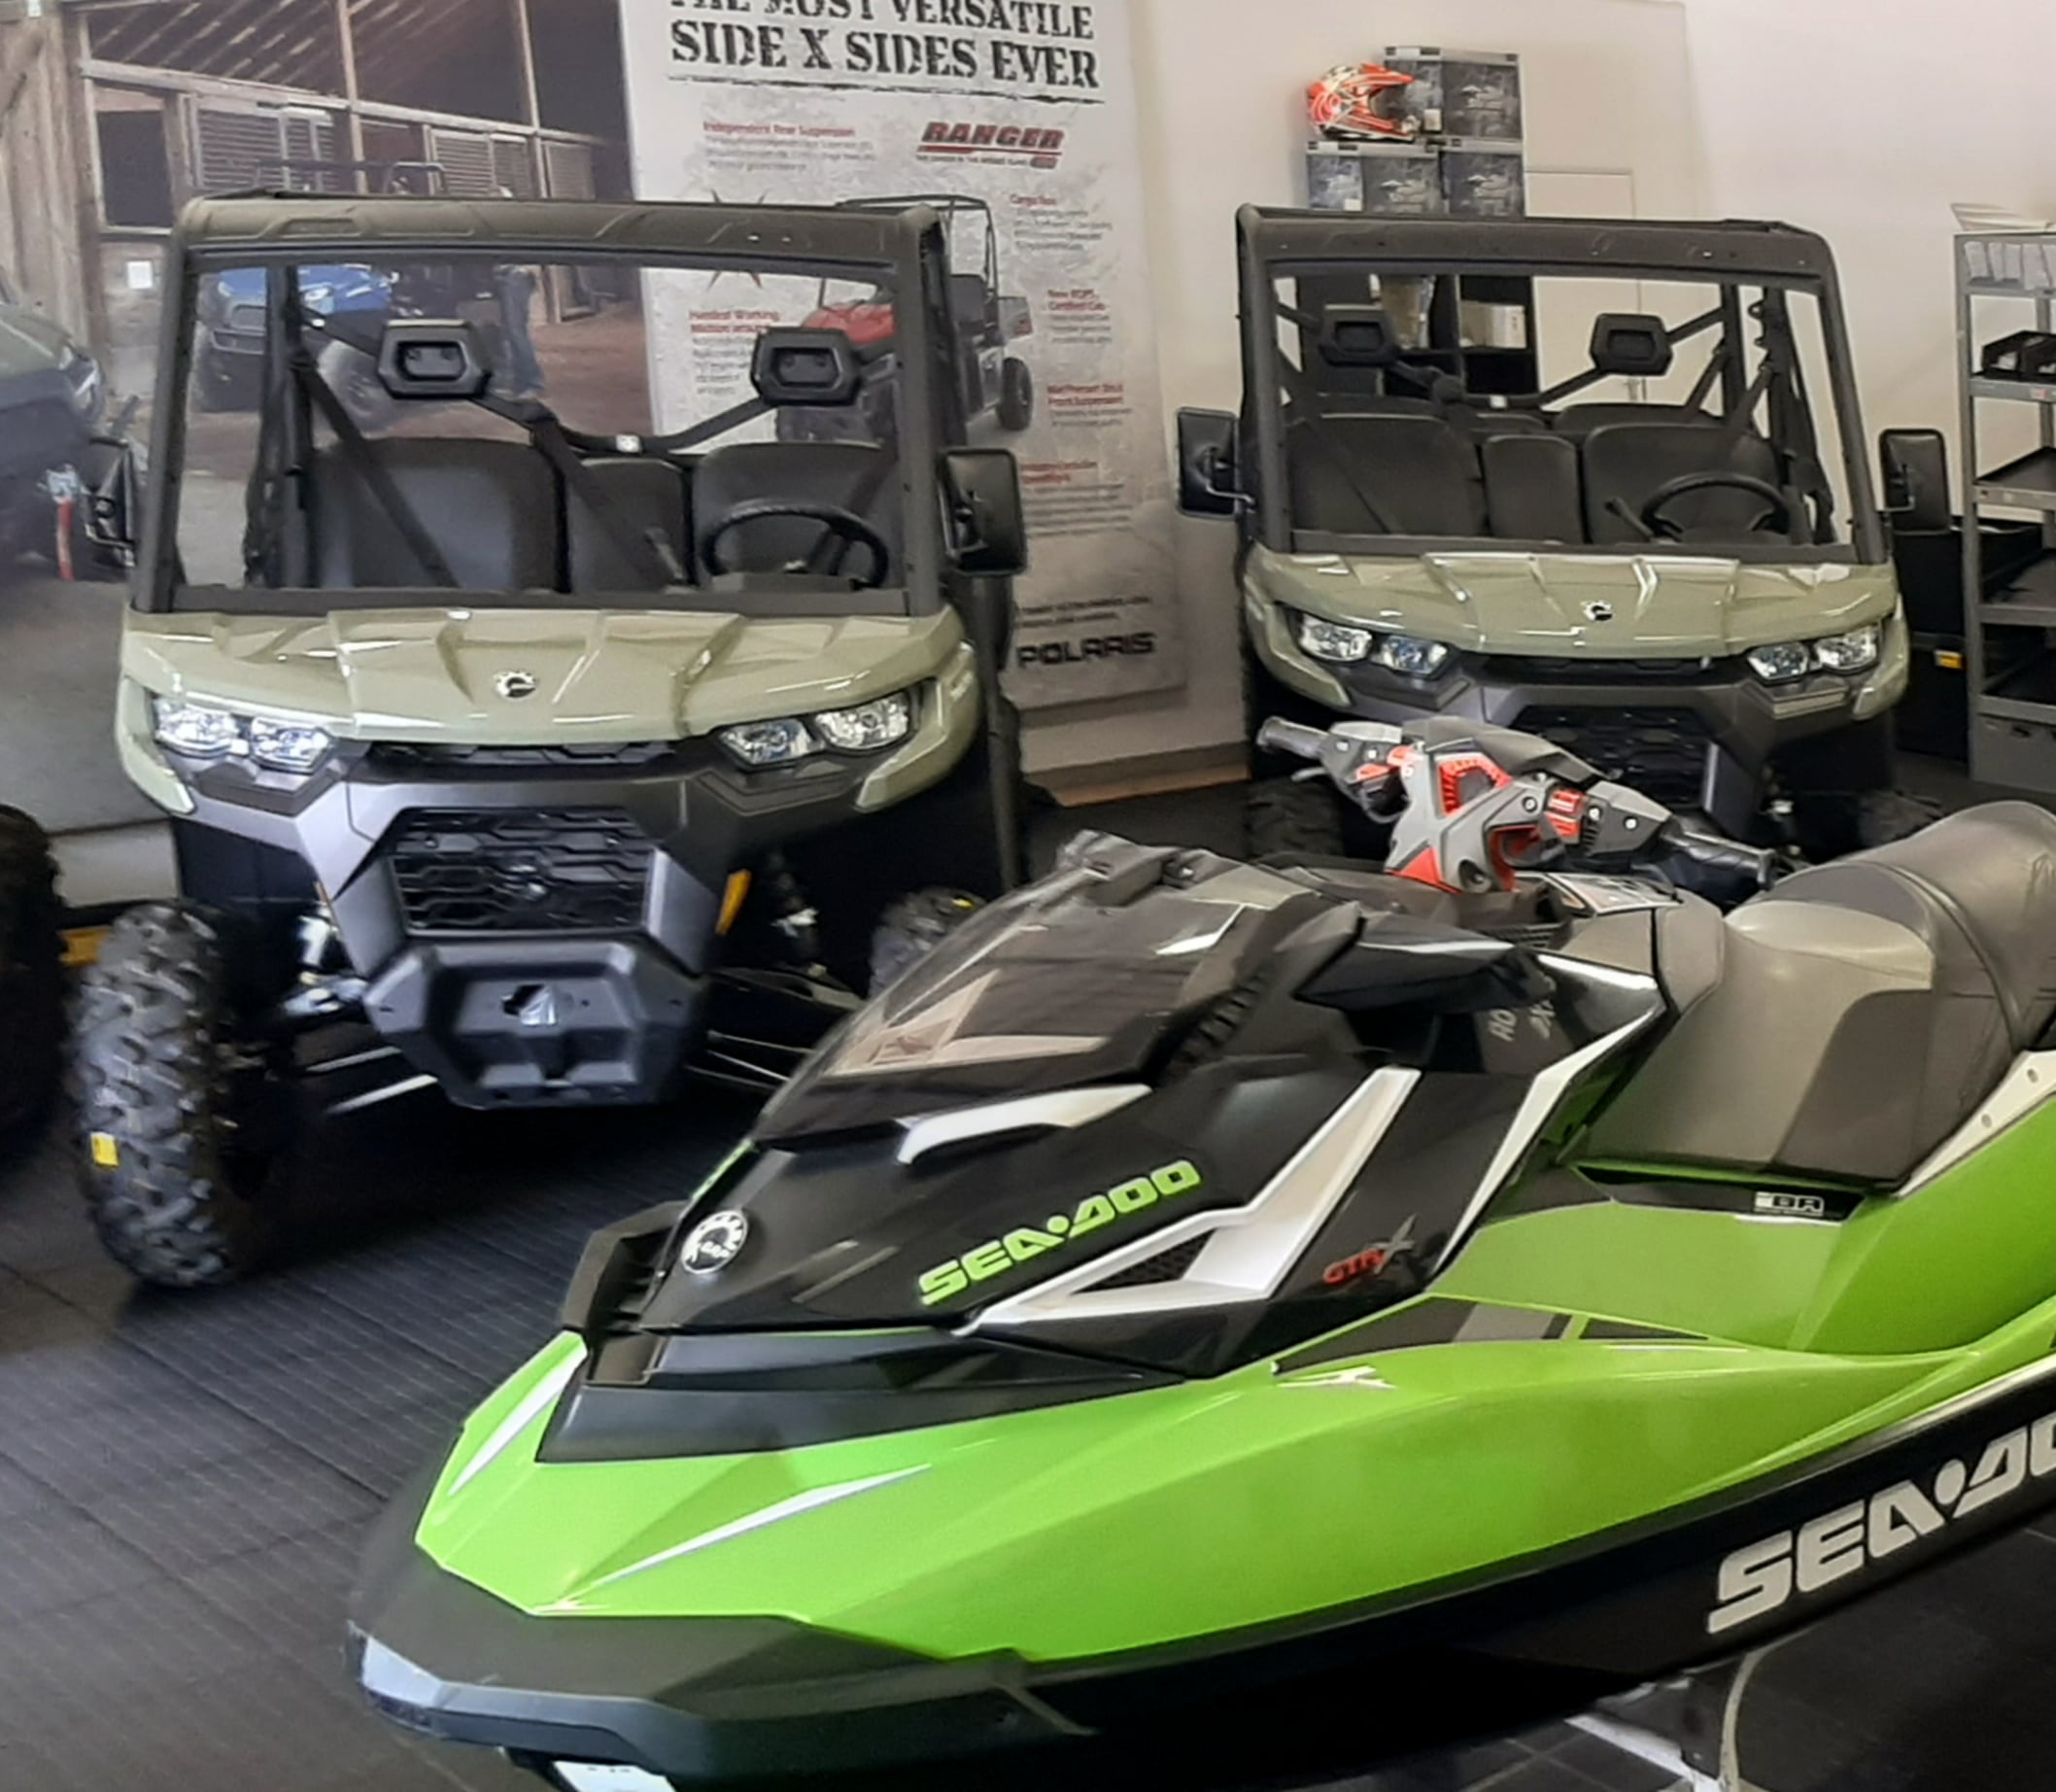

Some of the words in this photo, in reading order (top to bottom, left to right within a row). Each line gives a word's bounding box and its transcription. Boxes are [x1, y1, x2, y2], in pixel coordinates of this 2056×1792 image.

[892, 0, 1094, 40] VERSATILE
[671, 19, 787, 67] SIDE
[800, 28, 833, 70] X
[846, 31, 977, 78] SIDES
[990, 40, 1099, 88] EVER
[921, 121, 1065, 150] RANGER
[1017, 632, 1156, 668] POLARIS
